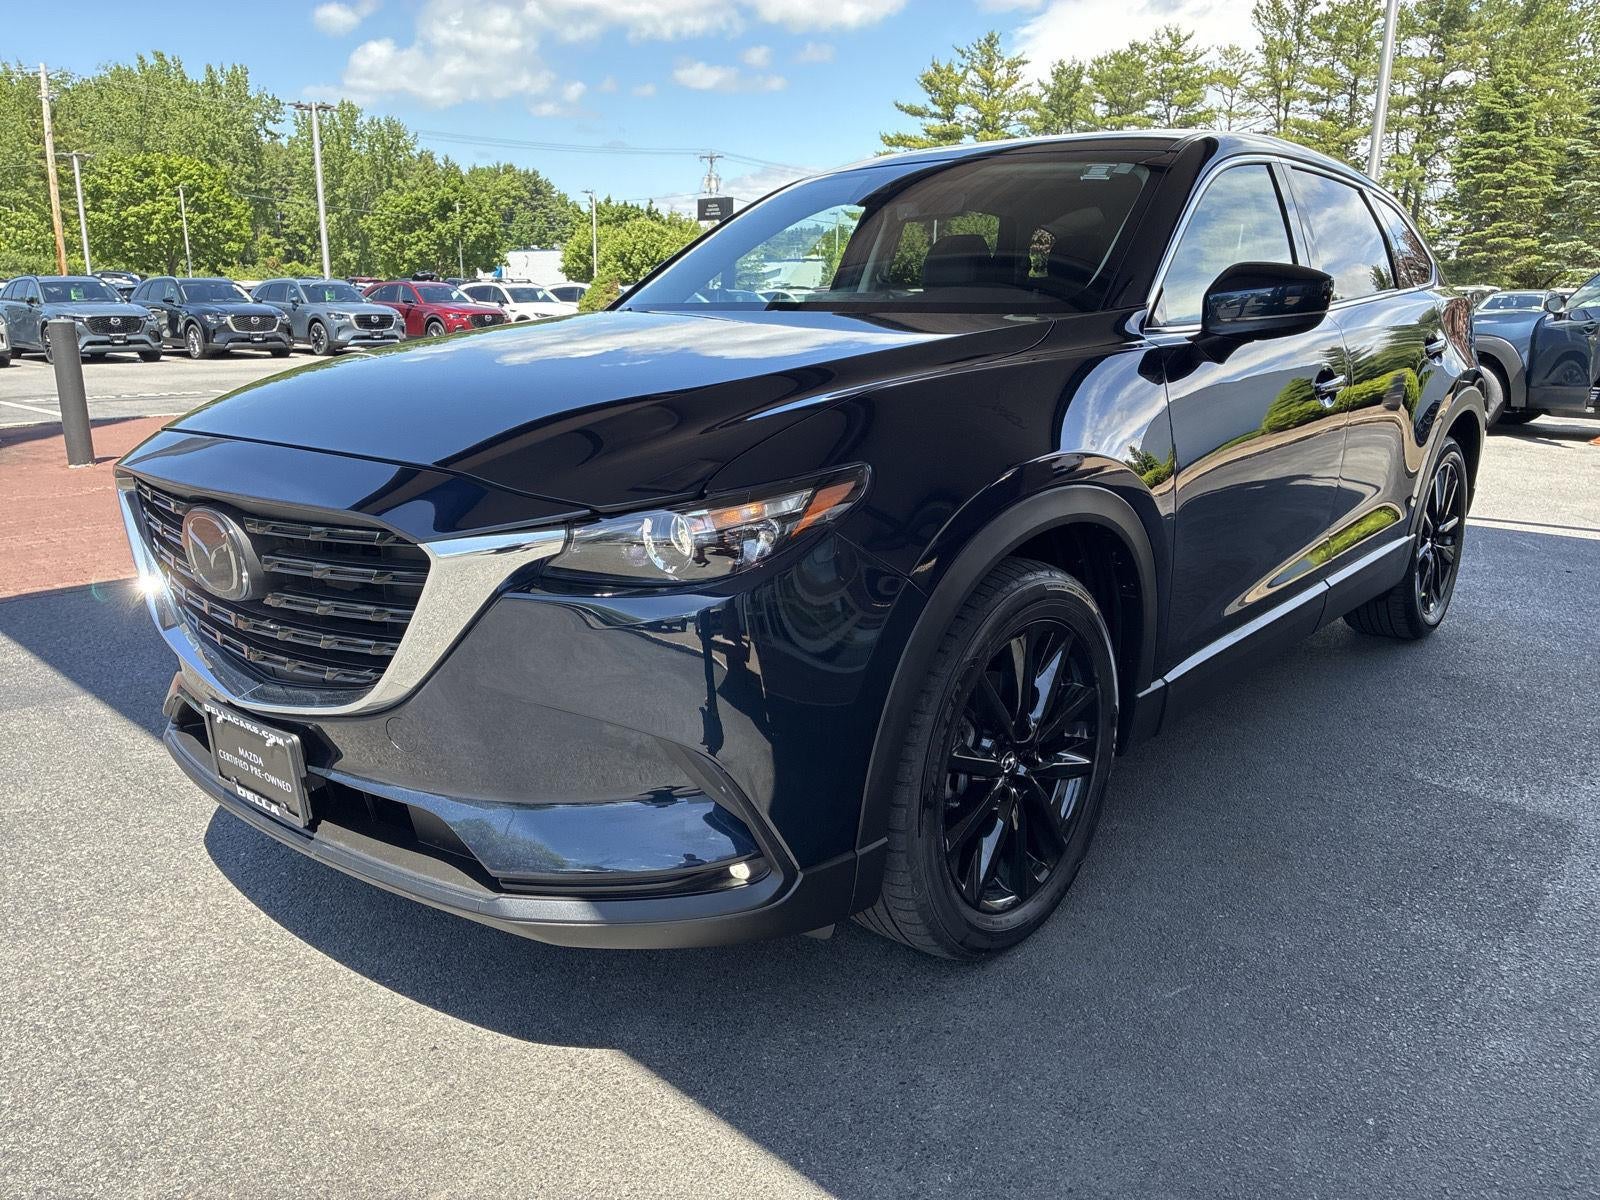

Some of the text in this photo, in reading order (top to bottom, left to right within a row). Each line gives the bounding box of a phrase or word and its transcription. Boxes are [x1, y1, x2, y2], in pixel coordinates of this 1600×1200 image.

[204, 703, 285, 747] DELLACARS.COM
[218, 749, 292, 793] CERTIFIED PRE-OWNED
[238, 747, 264, 767] MAZDA
[236, 784, 281, 816] DELLA
